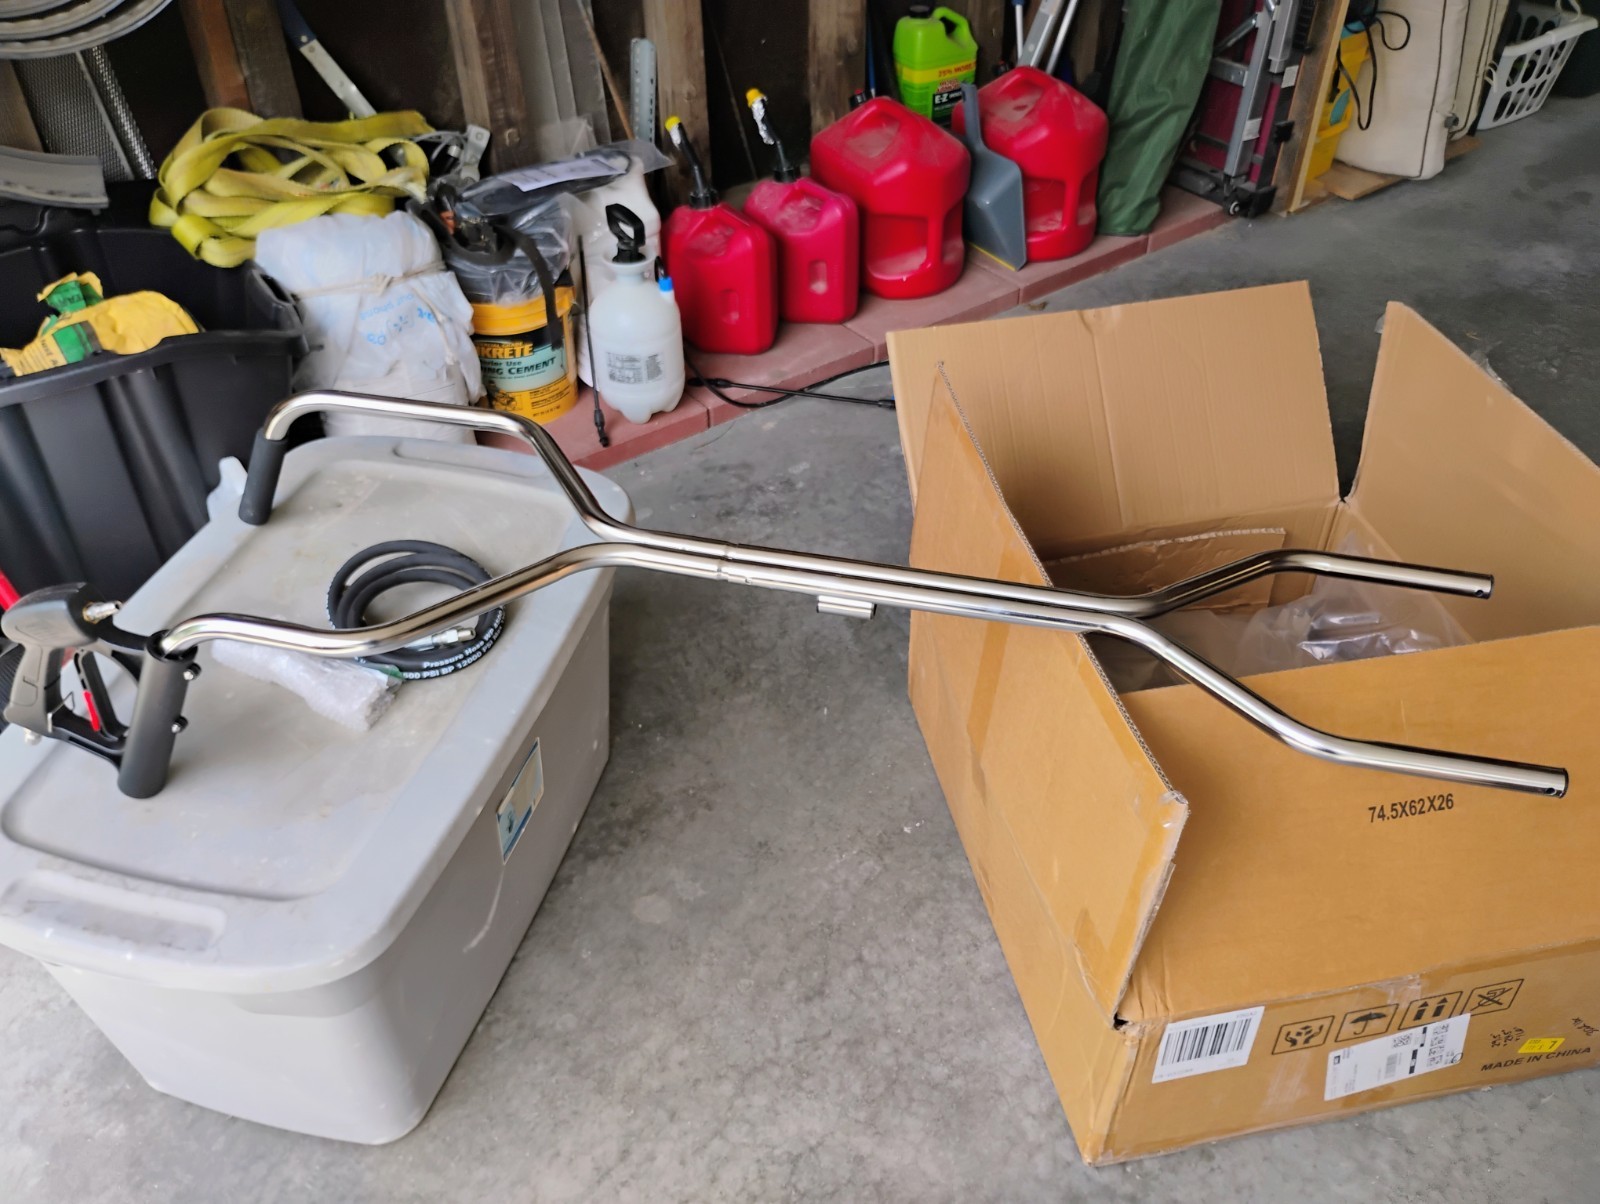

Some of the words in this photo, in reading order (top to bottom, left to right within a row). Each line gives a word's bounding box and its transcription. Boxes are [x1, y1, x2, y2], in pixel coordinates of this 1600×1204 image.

[508, 356, 557, 376] CEMENT
[422, 670, 440, 679] PSI
[441, 665, 455, 675] BP
[456, 651, 482, 669] 12000
[423, 653, 464, 669] Pressure
[464, 640, 485, 656] Hose
[1367, 793, 1455, 823] 74.5X62X26
[1480, 1057, 1524, 1072] MADE
[1526, 1054, 1543, 1063] IN
[1545, 1047, 1592, 1060] CHINA
